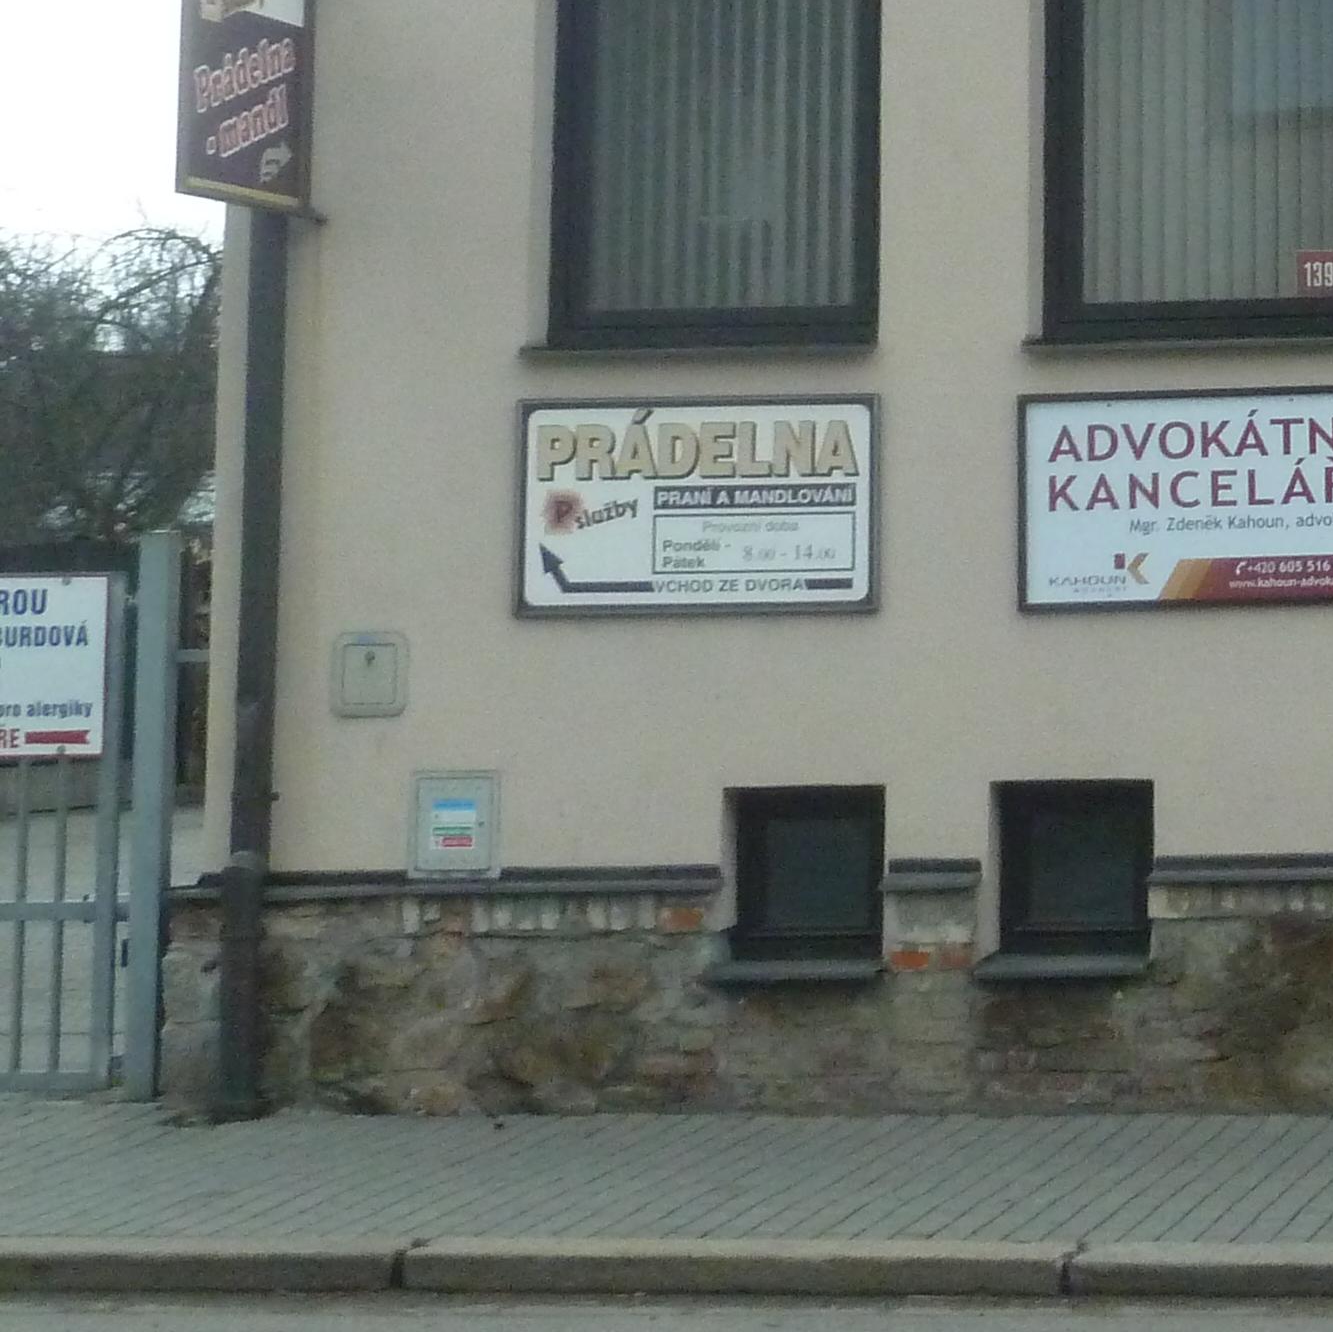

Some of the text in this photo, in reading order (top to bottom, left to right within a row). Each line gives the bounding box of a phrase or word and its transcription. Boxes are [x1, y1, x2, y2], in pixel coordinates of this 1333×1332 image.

[193, 38, 296, 113] Prádelna
[217, 84, 289, 158] mandl
[537, 408, 859, 482] PRÁDELNA
[657, 485, 852, 506] PRANÍ A MANDLOVÁNÍ
[1166, 515, 1223, 532] Zdeněk
[1227, 514, 1289, 530] Kahoun,
[1279, 560, 1303, 573] 605
[1306, 559, 1331, 572] 516
[654, 578, 804, 593] VCHOD ZE DVORA
[27, 700, 93, 719] alergiky
